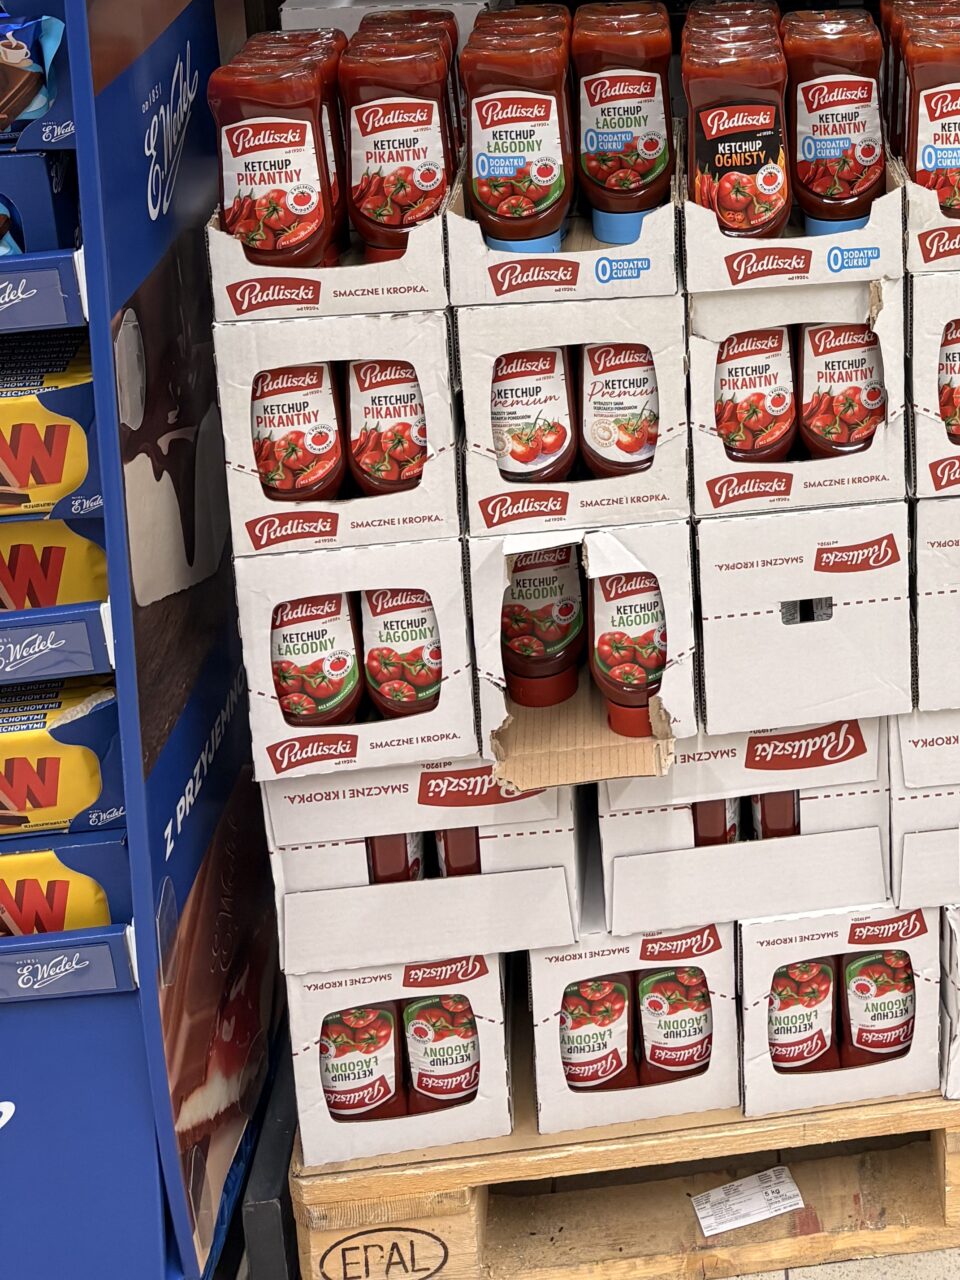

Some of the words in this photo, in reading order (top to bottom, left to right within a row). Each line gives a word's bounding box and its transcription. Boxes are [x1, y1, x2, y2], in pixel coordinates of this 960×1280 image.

[492, 130, 535, 140] KETCHUP
[487, 140, 542, 153] ŁAGODNY
[718, 141, 762, 153] KETCHUP
[244, 159, 291, 172] KETCHUP
[490, 158, 524, 167] DODATKU
[715, 151, 765, 167] OGNISTY
[237, 169, 302, 185] PIKANTNY
[490, 166, 514, 175] CUKRU
[598, 260, 610, 280] 0
[612, 260, 648, 269] DODATKU
[612, 269, 638, 277] CUKRU
[236, 281, 315, 310] Pudliszki
[333, 288, 379, 298] SMACZNE
[382, 287, 384, 295] I
[386, 285, 429, 295] KROPKA.
[604, 377, 648, 389] KETCHUP
[580, 498, 623, 508] SMACZNE
[630, 494, 670, 504] KROPKA.
[488, 495, 562, 523] Pudliszki
[164, 819, 174, 861] Z
